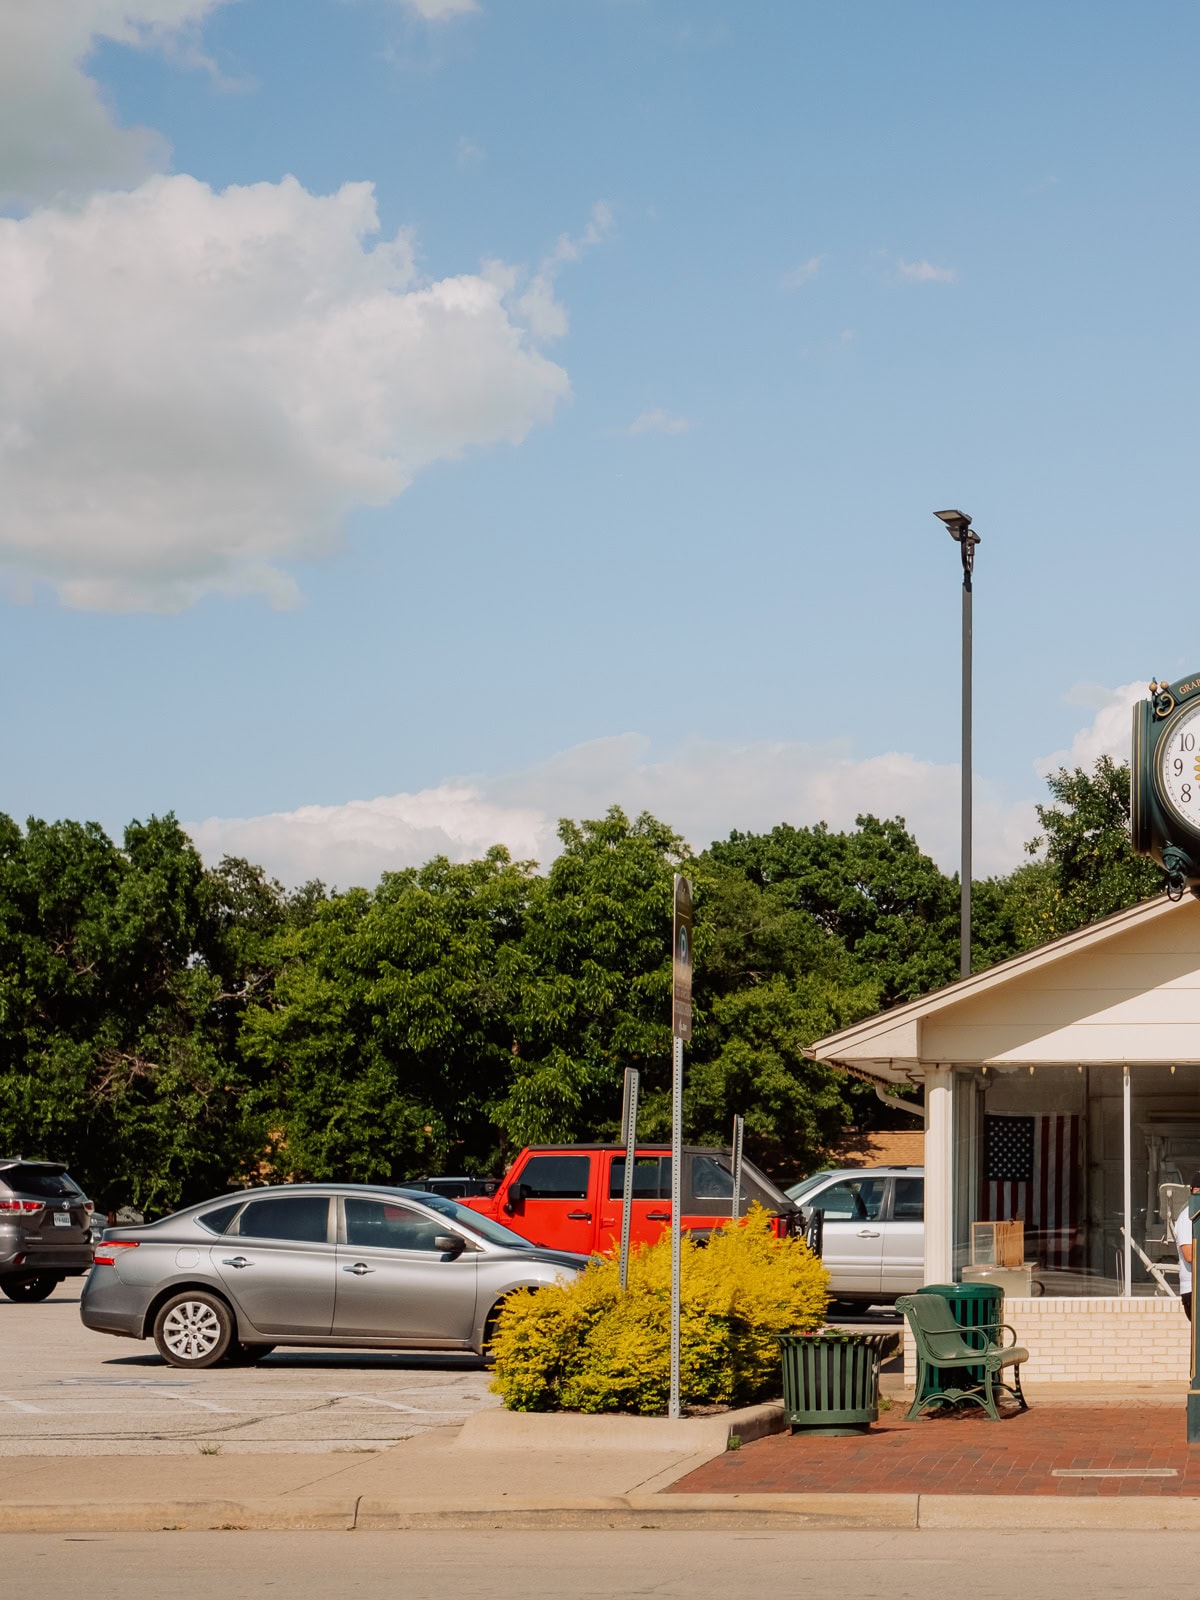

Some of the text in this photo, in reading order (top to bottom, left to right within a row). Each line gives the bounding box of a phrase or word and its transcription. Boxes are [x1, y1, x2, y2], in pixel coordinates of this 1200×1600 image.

[1179, 733, 1195, 752] 10
[1173, 758, 1184, 777] 9
[1180, 783, 1192, 803] 8
